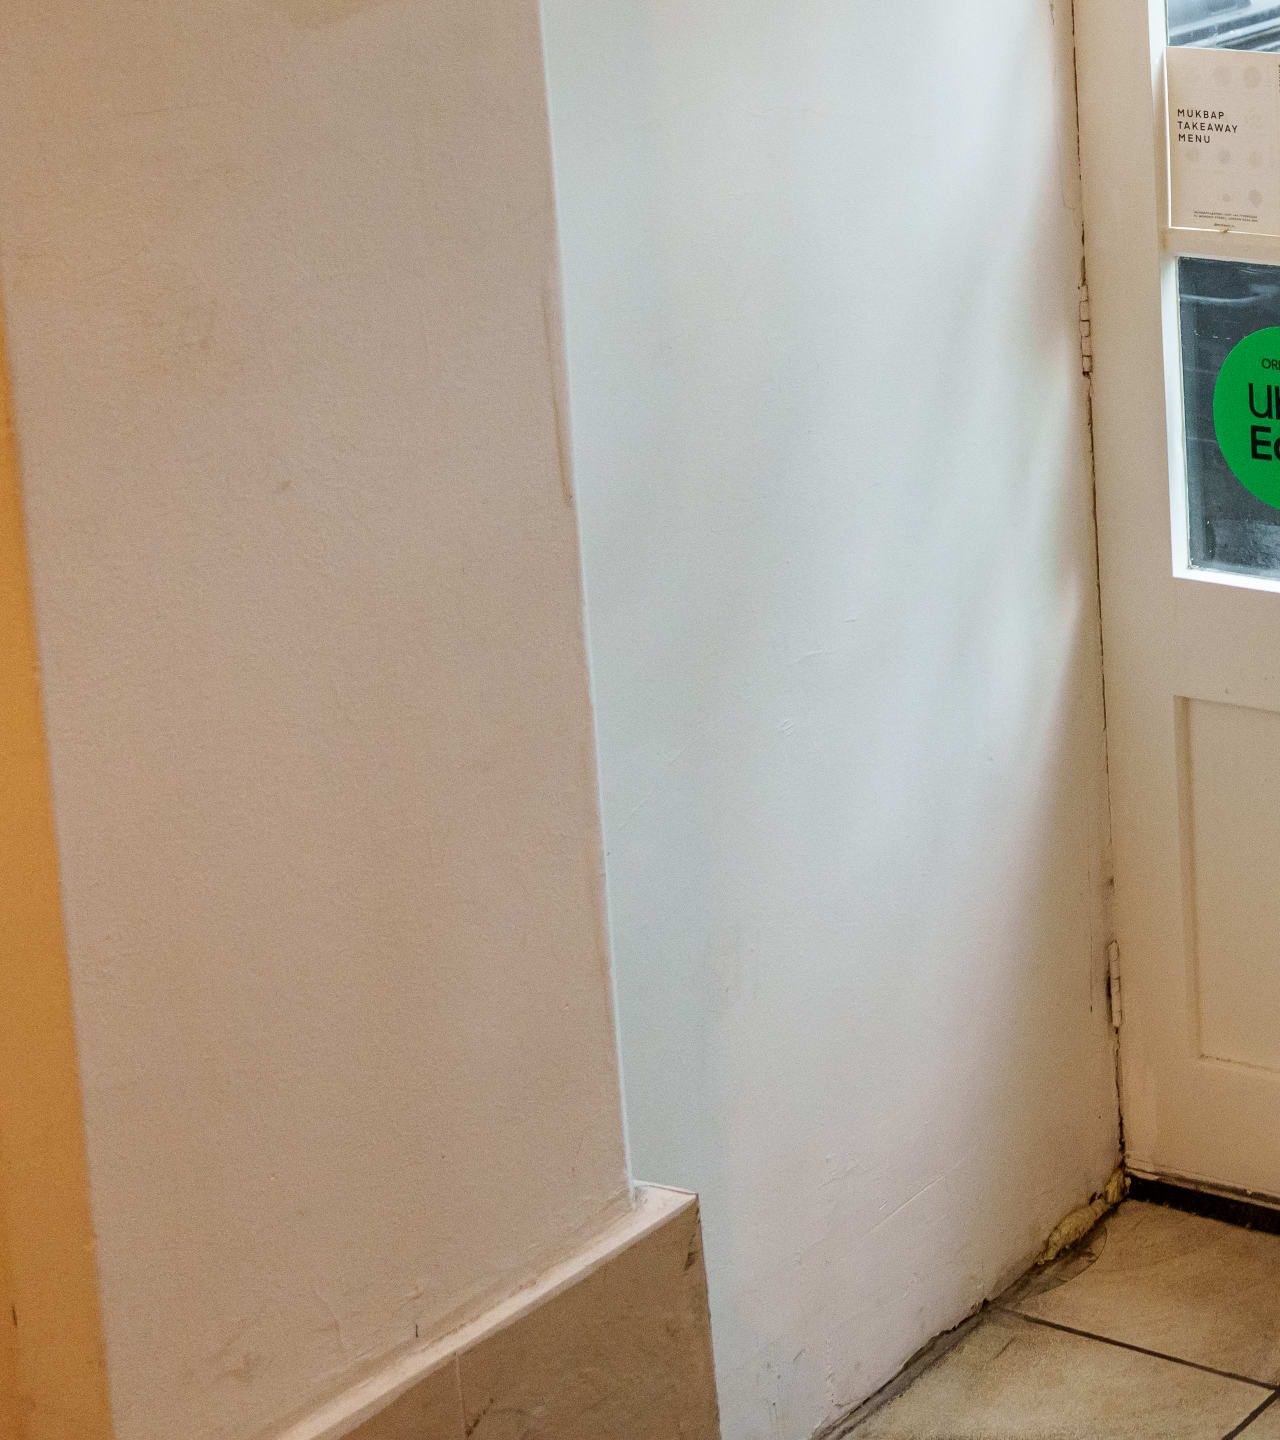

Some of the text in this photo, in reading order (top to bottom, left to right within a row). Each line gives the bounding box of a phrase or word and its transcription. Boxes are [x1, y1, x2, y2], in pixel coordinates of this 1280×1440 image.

[1177, 108, 1226, 121] MUKBAP
[1177, 121, 1238, 134] TAKEAWAY
[1178, 133, 1211, 144] MENU
